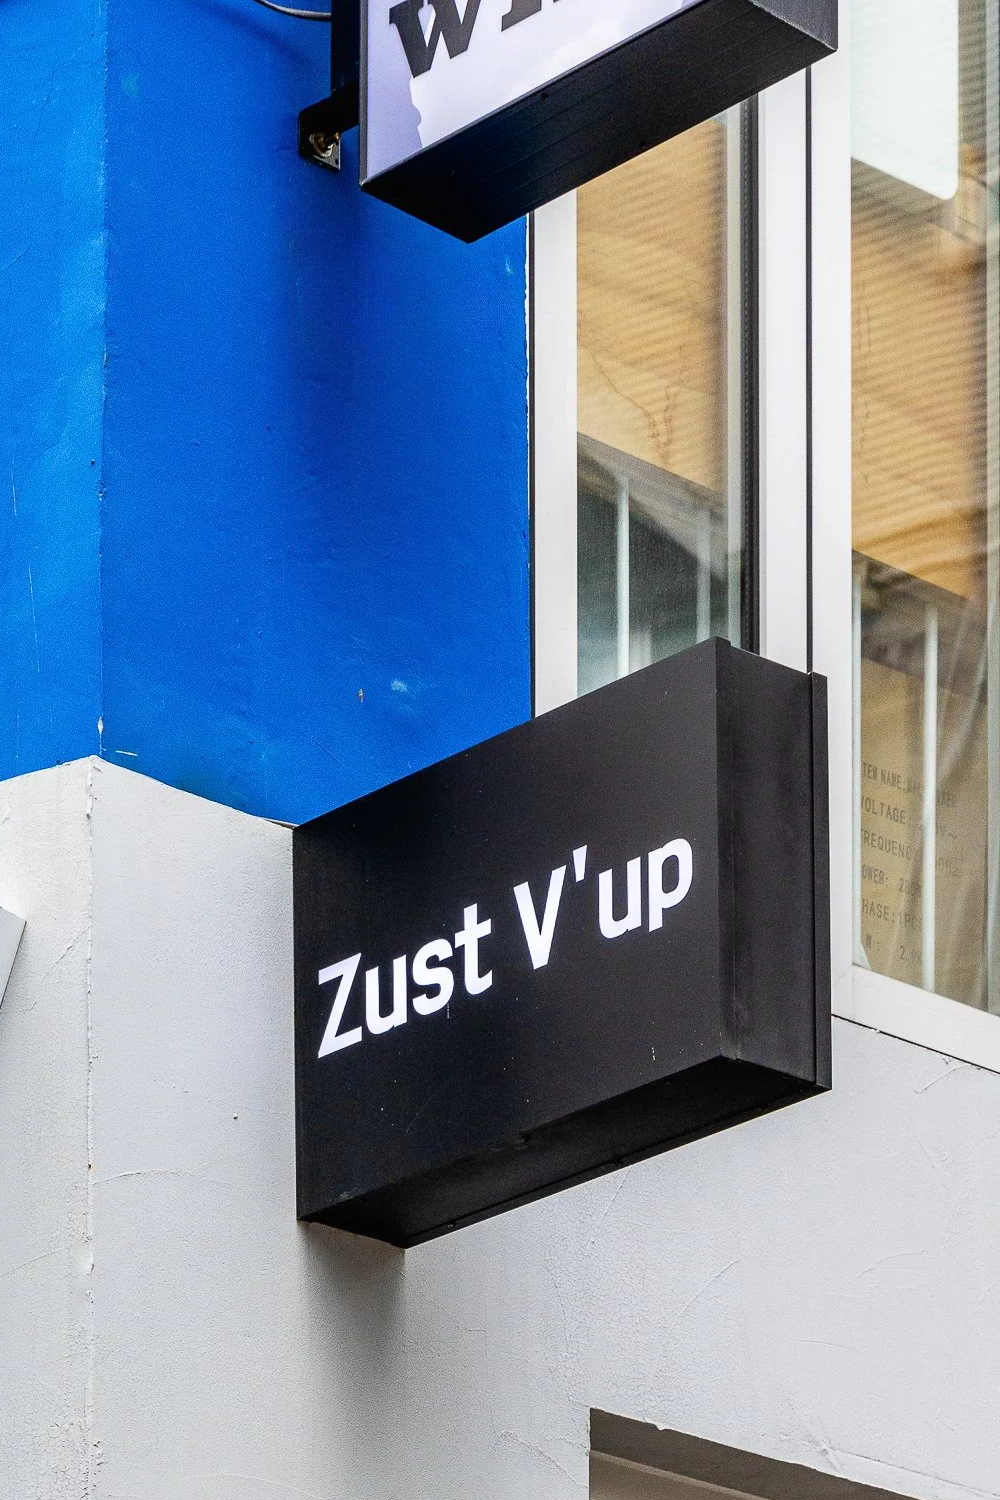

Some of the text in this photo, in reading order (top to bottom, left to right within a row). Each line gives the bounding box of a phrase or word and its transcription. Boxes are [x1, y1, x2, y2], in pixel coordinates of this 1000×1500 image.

[861, 828, 917, 862] REQUENC
[861, 897, 895, 923] HASE:
[317, 837, 694, 1059] Zust V'up
